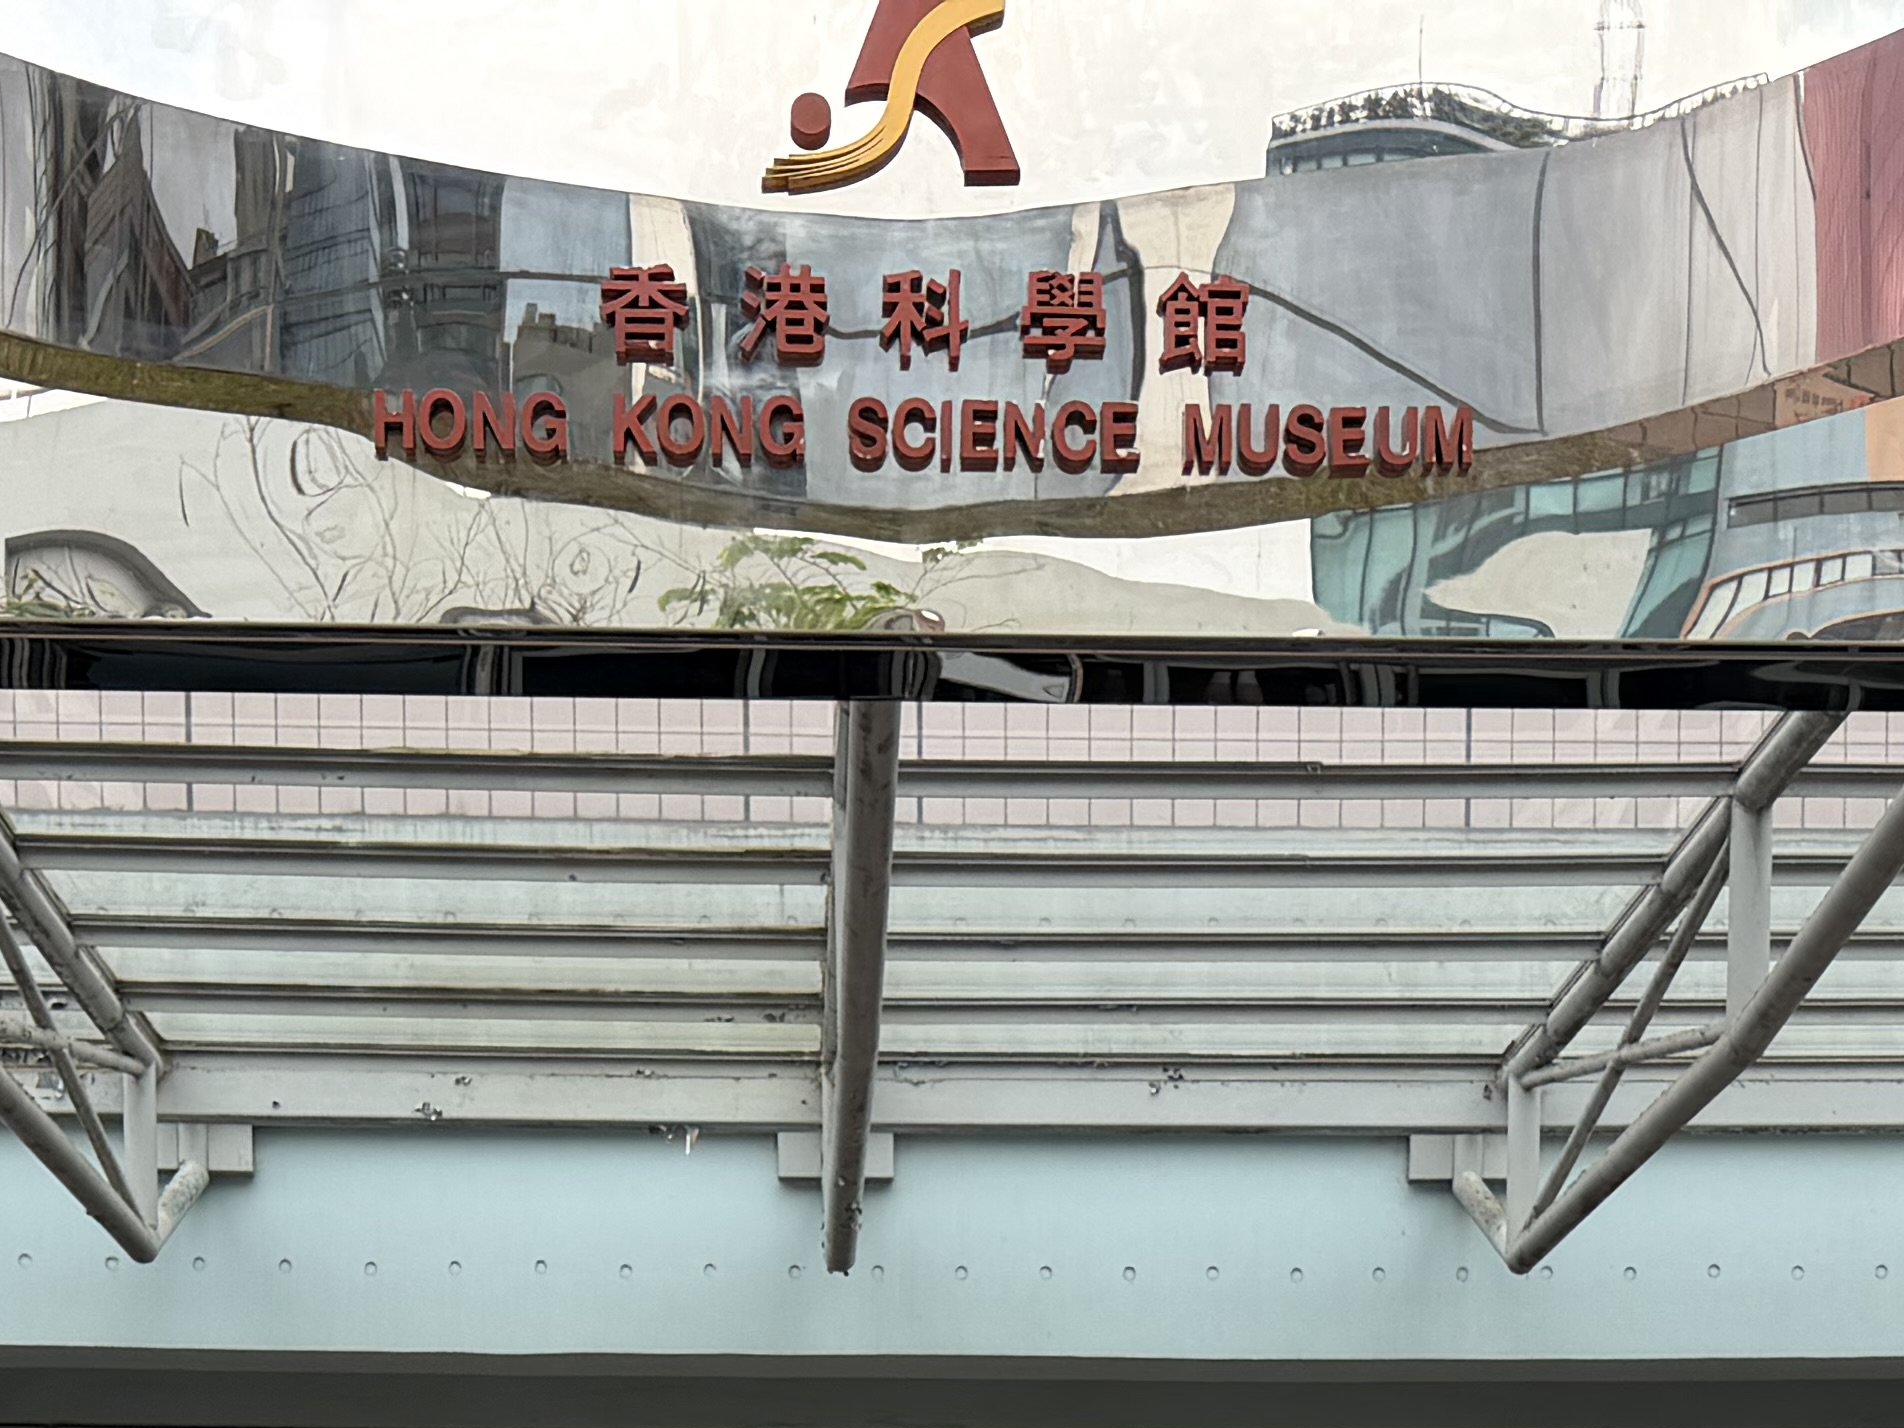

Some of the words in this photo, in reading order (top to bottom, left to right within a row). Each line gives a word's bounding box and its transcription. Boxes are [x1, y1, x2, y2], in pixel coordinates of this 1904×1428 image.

[599, 263, 1251, 374] 香港科學館
[373, 385, 569, 464] HONG
[611, 388, 806, 461] KONG
[847, 393, 1142, 475] SCIENCE
[1181, 399, 1475, 479] MUSEUM
